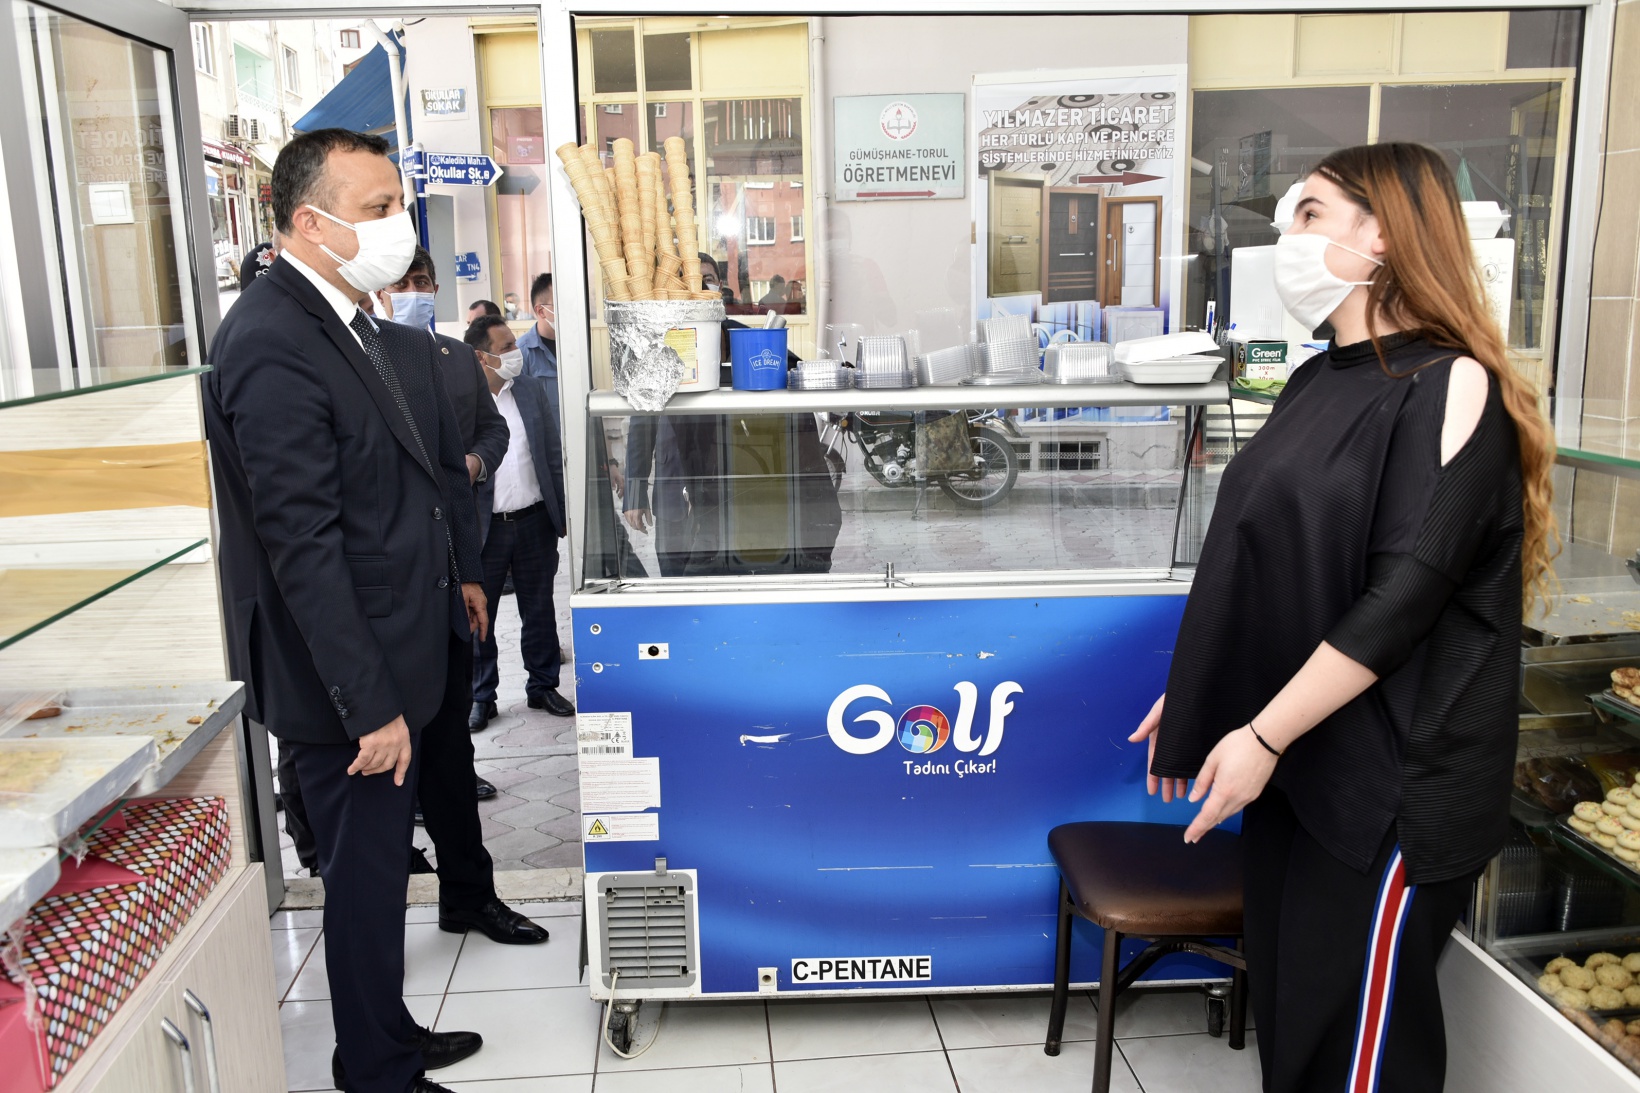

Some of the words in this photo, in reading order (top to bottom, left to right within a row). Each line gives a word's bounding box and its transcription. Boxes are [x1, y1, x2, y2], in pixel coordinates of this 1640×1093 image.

[425, 89, 460, 100] OKULLAR
[426, 101, 460, 111] SOKAK
[983, 107, 1083, 128] YILMAZER
[1088, 103, 1173, 125] TİCARET
[982, 134, 1008, 147] HER
[1011, 131, 1054, 146] TÜRLÜ
[1057, 131, 1088, 145] KAPI
[1092, 131, 1108, 144] VE
[1112, 129, 1174, 143] PENCERE
[440, 155, 467, 165] Kaledibi
[850, 148, 949, 161] GÜMÜŞHANE-TORUL
[982, 149, 1072, 164] SİSTEMLERİNDE
[1074, 146, 1173, 162] HİZMETİNİZDEYİZ
[429, 165, 466, 179] Okullar
[468, 167, 484, 179] Sk.
[843, 161, 956, 183] ÖĞRETMENEVİ
[467, 263, 480, 271] TN4
[1251, 347, 1281, 358] Green
[752, 359, 763, 367] ICE
[763, 358, 780, 367] DREAM
[827, 680, 1024, 756] Golf
[903, 760, 950, 775] Tadını
[954, 759, 996, 778] Çıkar!
[793, 958, 930, 981] C-PENTANE
